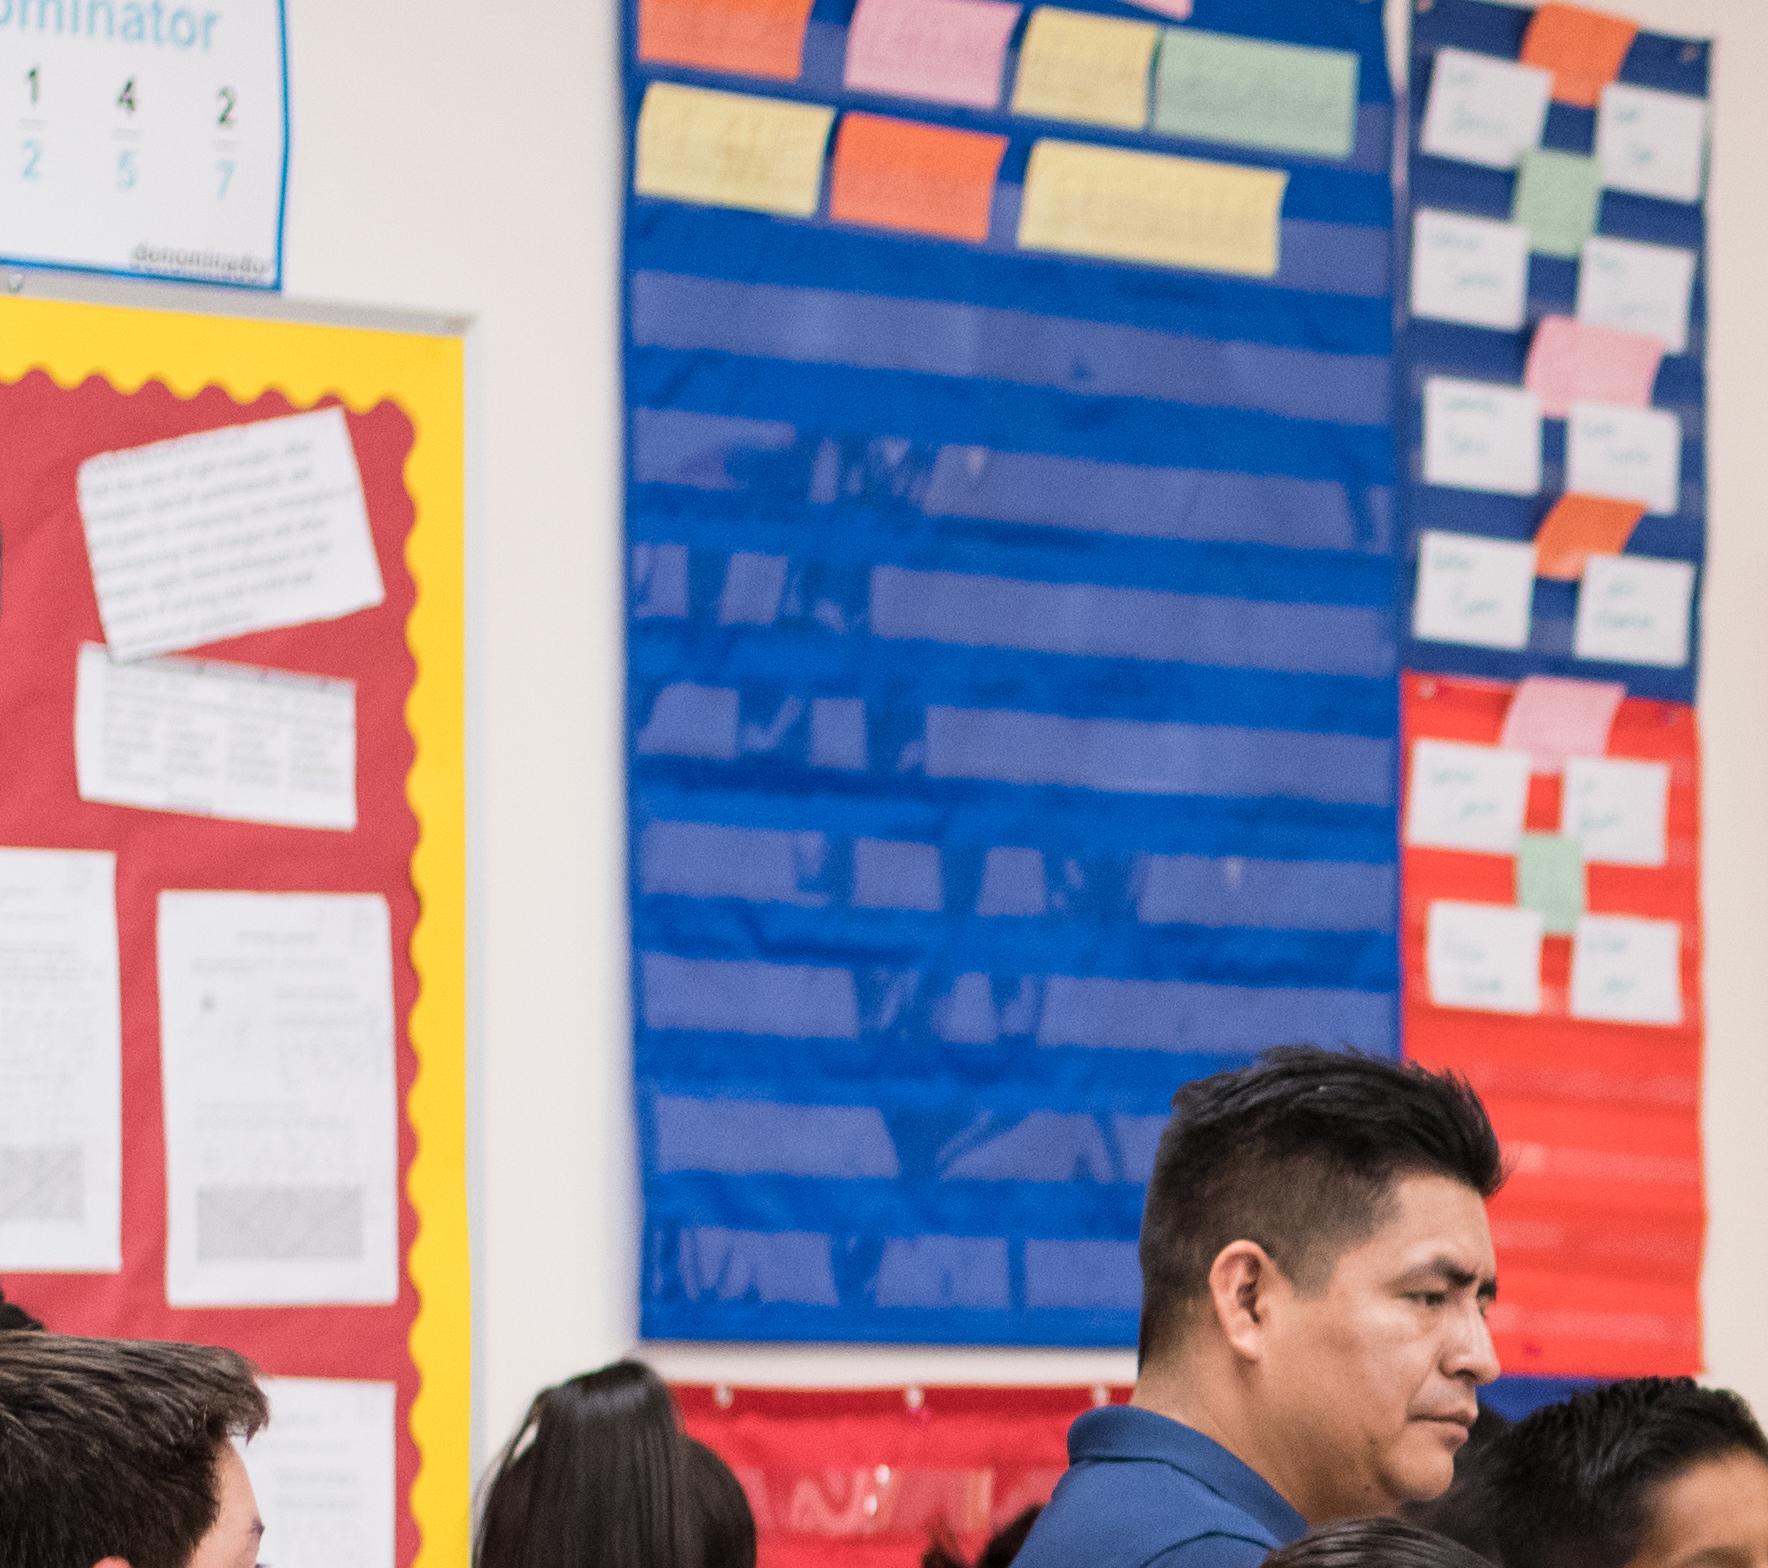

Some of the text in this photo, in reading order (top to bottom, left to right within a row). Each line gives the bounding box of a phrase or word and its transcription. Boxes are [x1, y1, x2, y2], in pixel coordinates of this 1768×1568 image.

[25, 65, 237, 128] 1 4 2
[21, 140, 235, 199] 2 5 7
